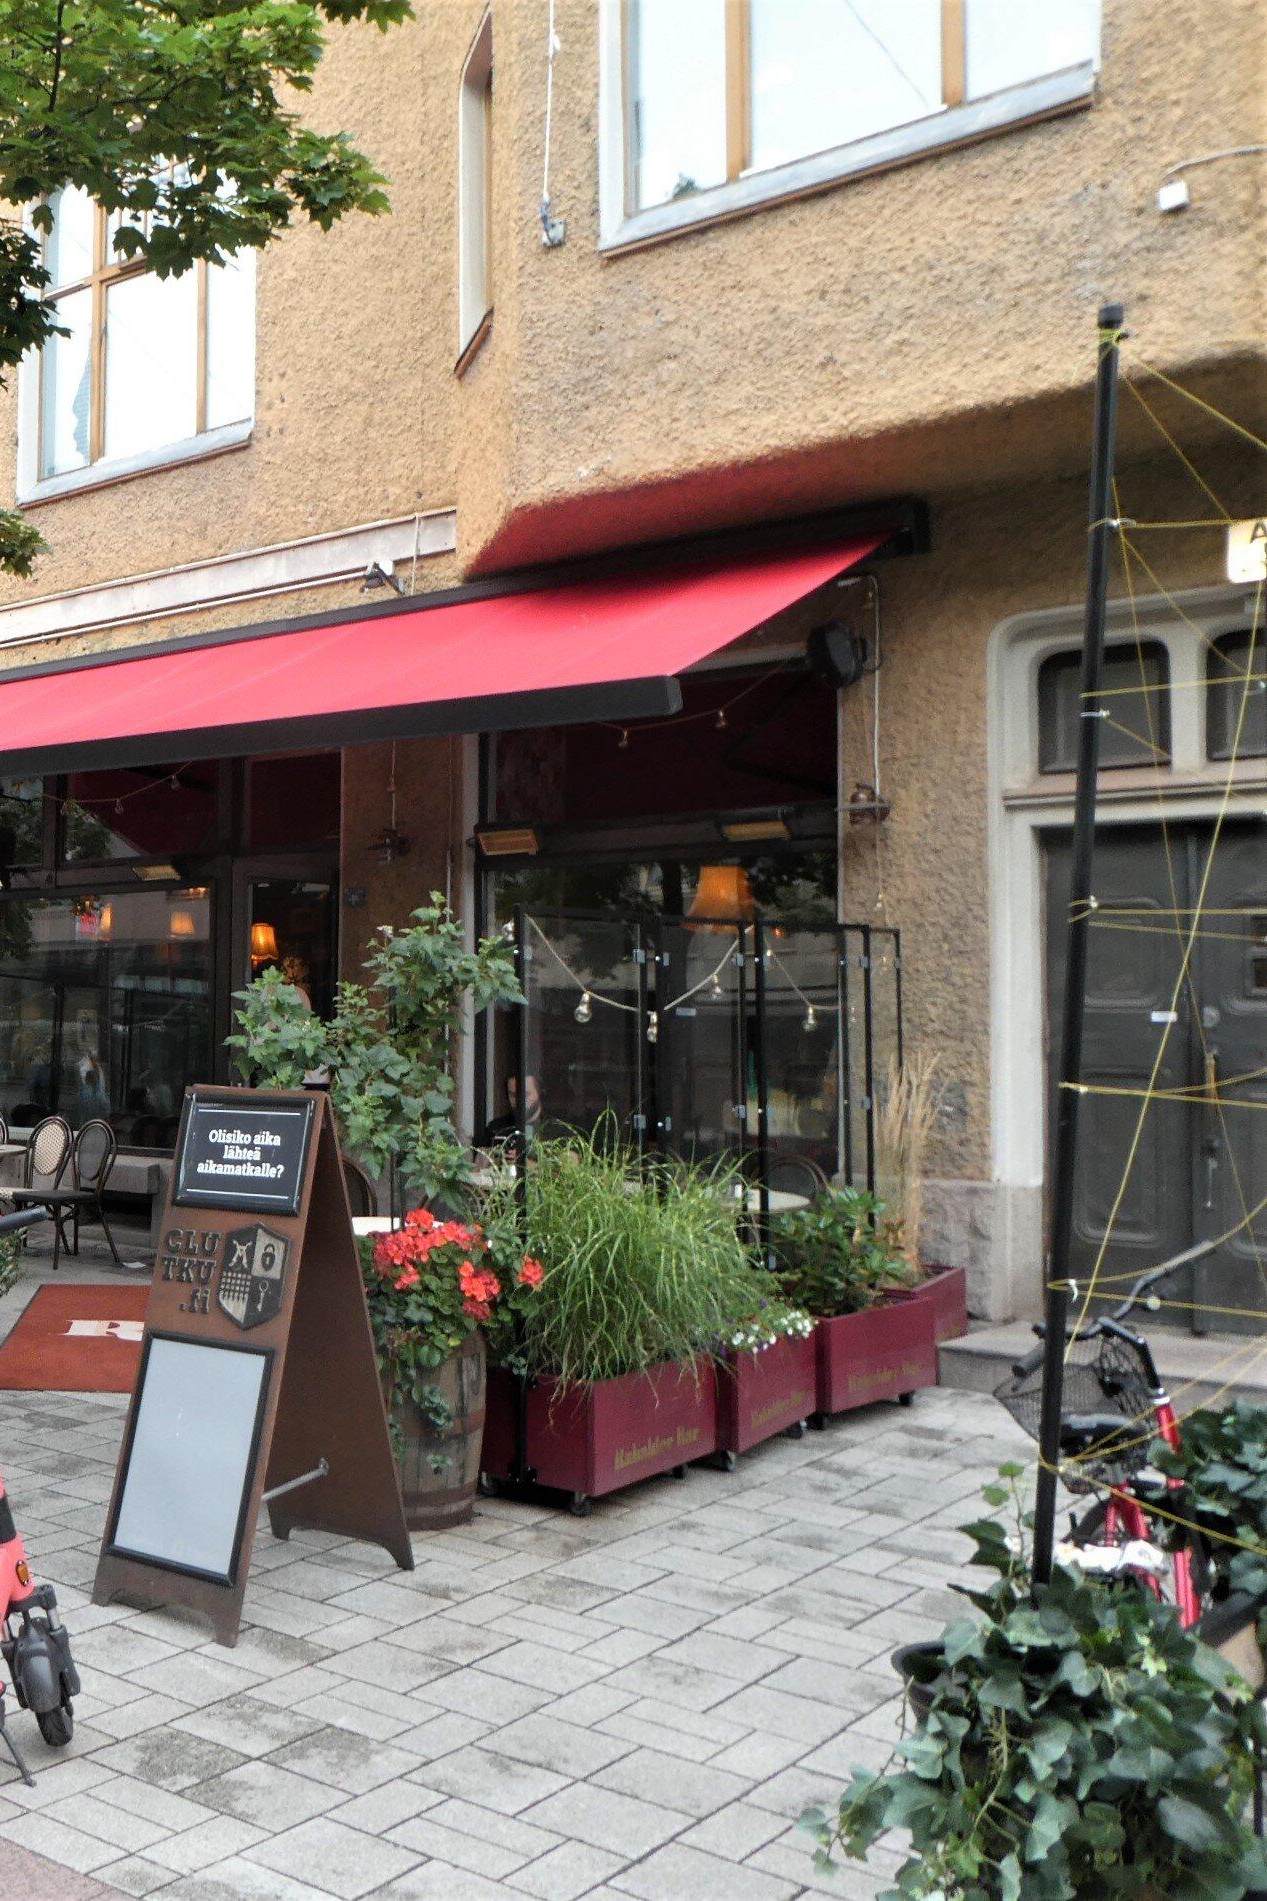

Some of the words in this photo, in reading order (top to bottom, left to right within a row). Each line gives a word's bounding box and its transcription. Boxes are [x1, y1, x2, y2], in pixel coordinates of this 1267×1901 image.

[208, 1128, 251, 1145] Olisiko
[253, 1130, 281, 1146] aika
[222, 1144, 262, 1160] lähteä
[196, 1159, 285, 1178] aikamatkalle?
[161, 1255, 217, 1284] TKU
